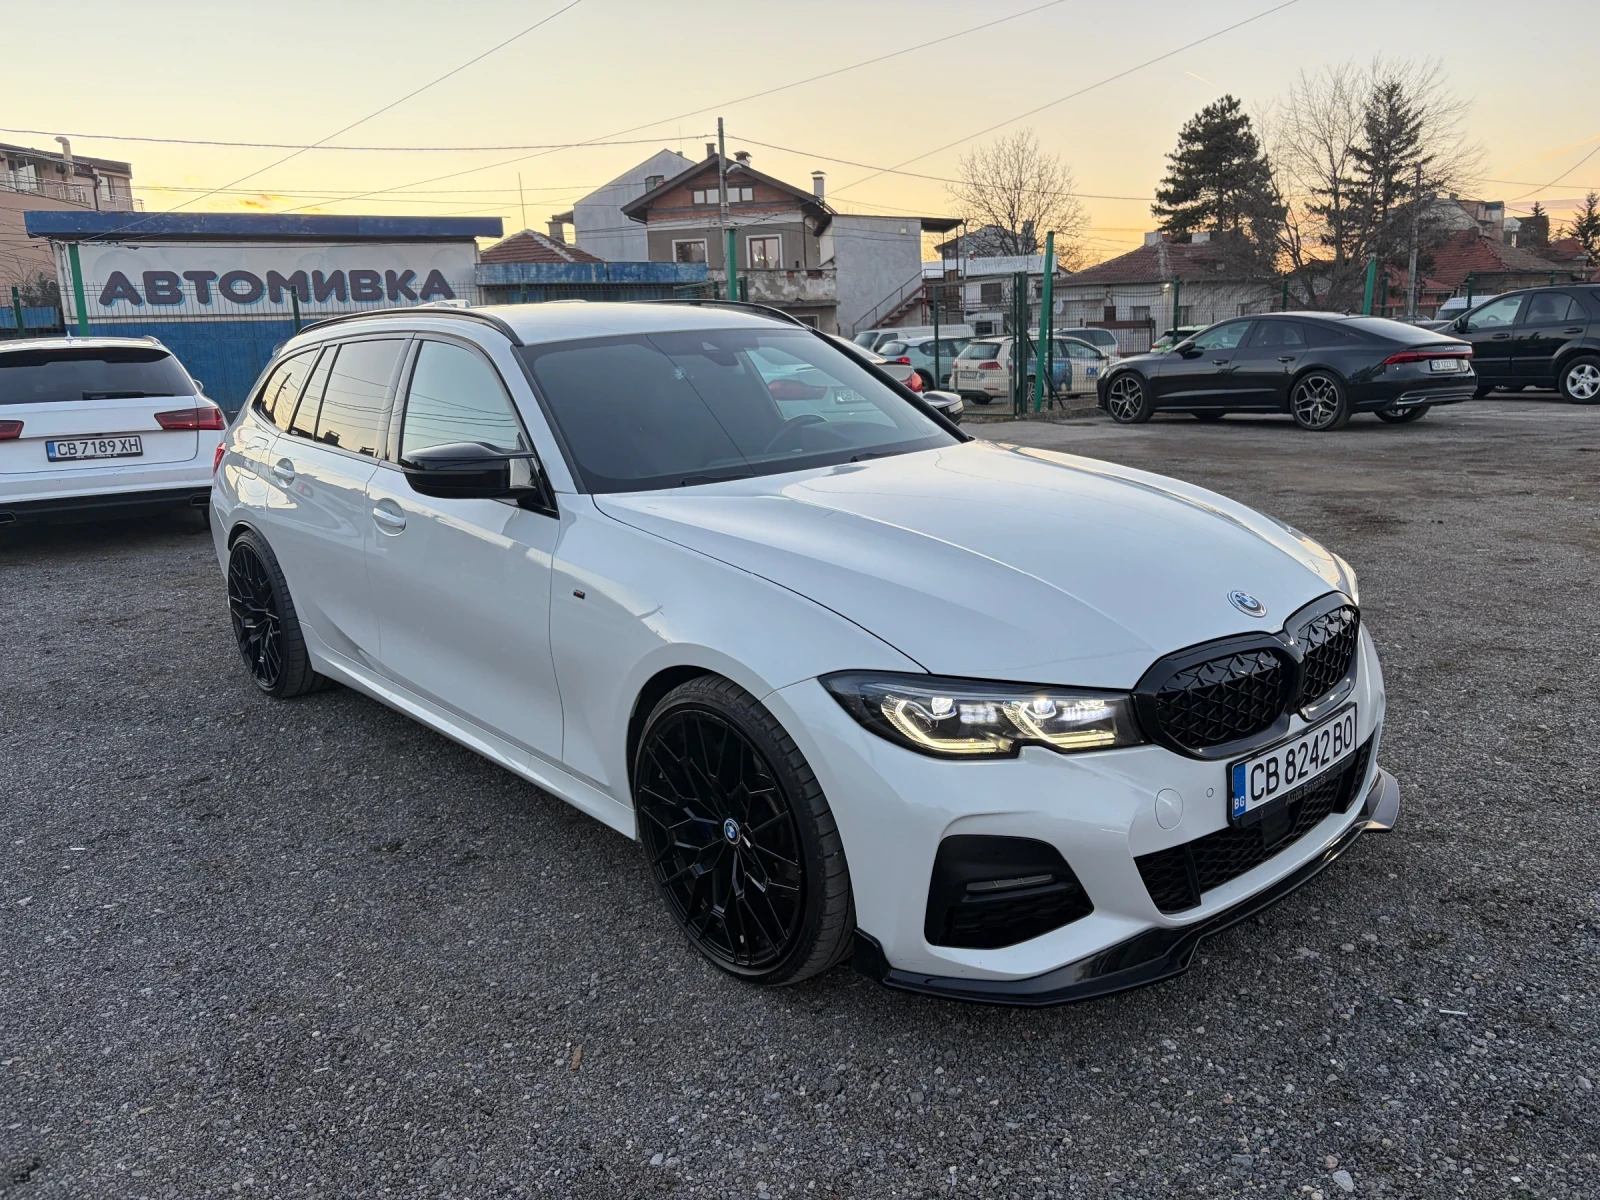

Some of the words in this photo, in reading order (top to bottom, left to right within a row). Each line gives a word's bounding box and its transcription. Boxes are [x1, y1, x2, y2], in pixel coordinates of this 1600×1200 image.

[98, 269, 456, 306] АВТОМИВКА
[57, 442, 78, 456] CB
[80, 440, 116, 455] 7189
[118, 438, 139, 452] XH
[1250, 756, 1280, 801] CB
[1284, 729, 1330, 785] 8242
[1234, 795, 1245, 810] BG
[1285, 790, 1303, 806] Auto
